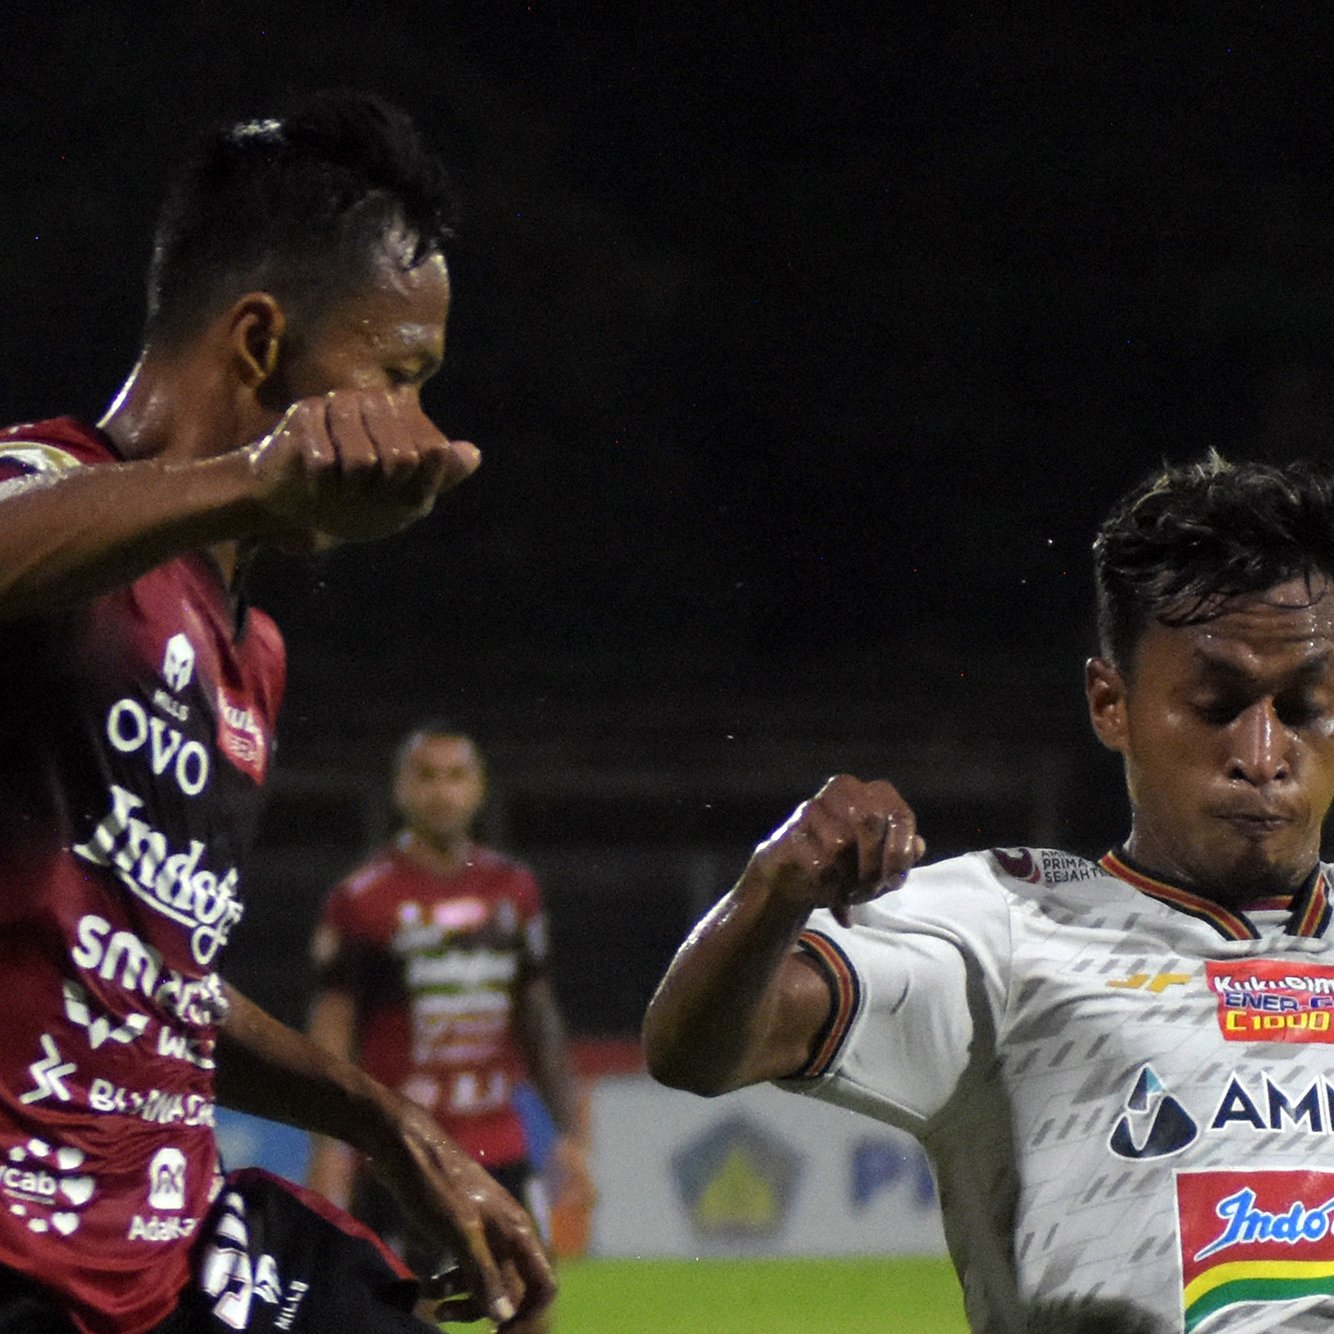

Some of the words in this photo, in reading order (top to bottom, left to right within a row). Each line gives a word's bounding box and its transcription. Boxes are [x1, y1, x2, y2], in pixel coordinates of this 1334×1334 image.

[108, 698, 209, 796] OVO
[1042, 857, 1089, 870] PRIMA
[1044, 867, 1113, 883] SEJAHT
